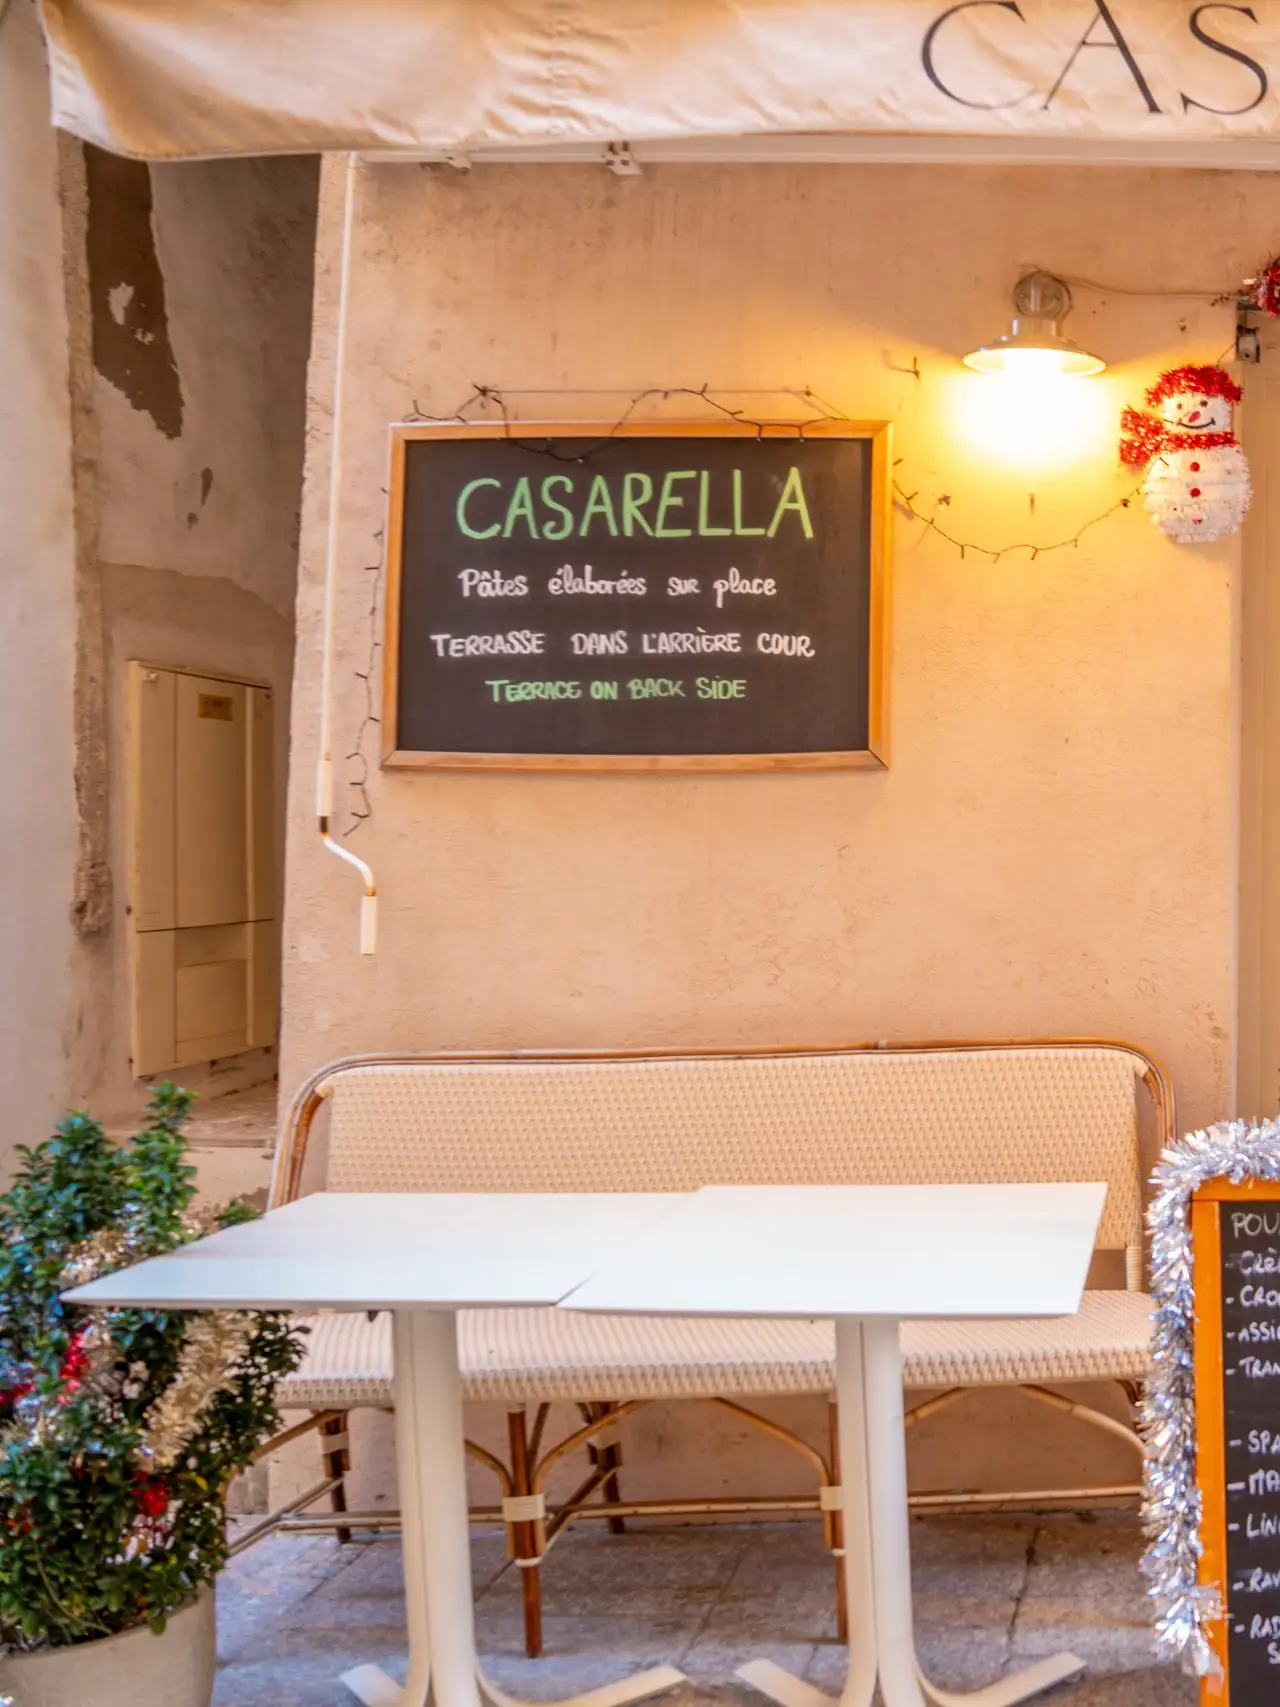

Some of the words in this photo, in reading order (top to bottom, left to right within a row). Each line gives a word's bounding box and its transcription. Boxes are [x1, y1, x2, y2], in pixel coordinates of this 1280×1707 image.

[456, 466, 814, 540] CASARELLA
[457, 568, 529, 597] Pâtes
[547, 564, 648, 596] élaborées
[712, 567, 777, 608] place
[429, 629, 547, 658] TERRASSE
[570, 630, 629, 656] DANS
[757, 632, 816, 658] COUR
[485, 679, 582, 703] TERRACE
[590, 680, 619, 700] ON
[627, 678, 686, 700] BACK
